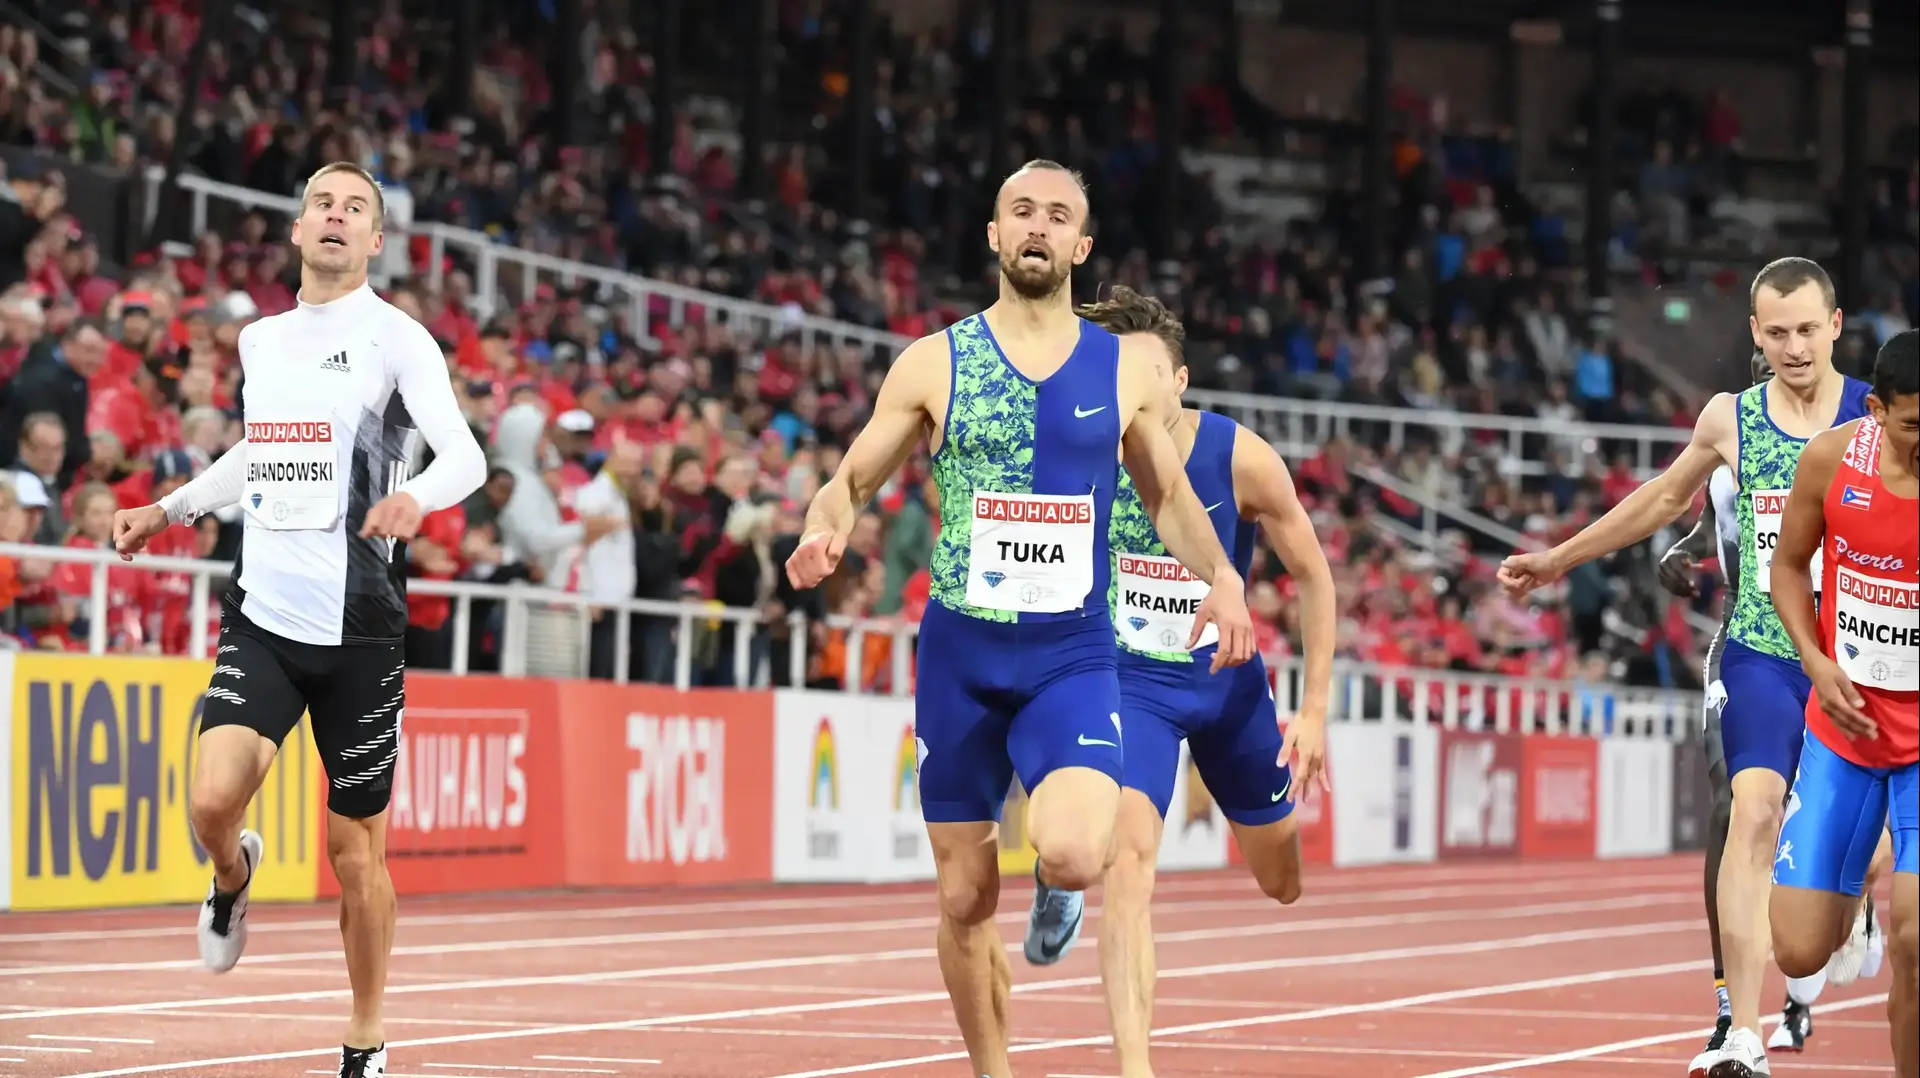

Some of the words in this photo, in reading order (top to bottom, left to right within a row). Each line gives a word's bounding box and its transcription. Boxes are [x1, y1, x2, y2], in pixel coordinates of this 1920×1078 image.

[248, 424, 331, 441] BAUHAUS
[247, 462, 333, 481] LEWANDOWSKI
[977, 498, 1090, 523] BAUHAUS
[997, 541, 1065, 563] TUKA
[1834, 534, 1905, 570] Puerto
[1121, 559, 1200, 580] BAUHA
[1125, 589, 1202, 615] KRAME
[1838, 610, 1919, 647] SANCHE
[391, 732, 527, 832] AUHAUS
[625, 711, 727, 865] RYOBI
